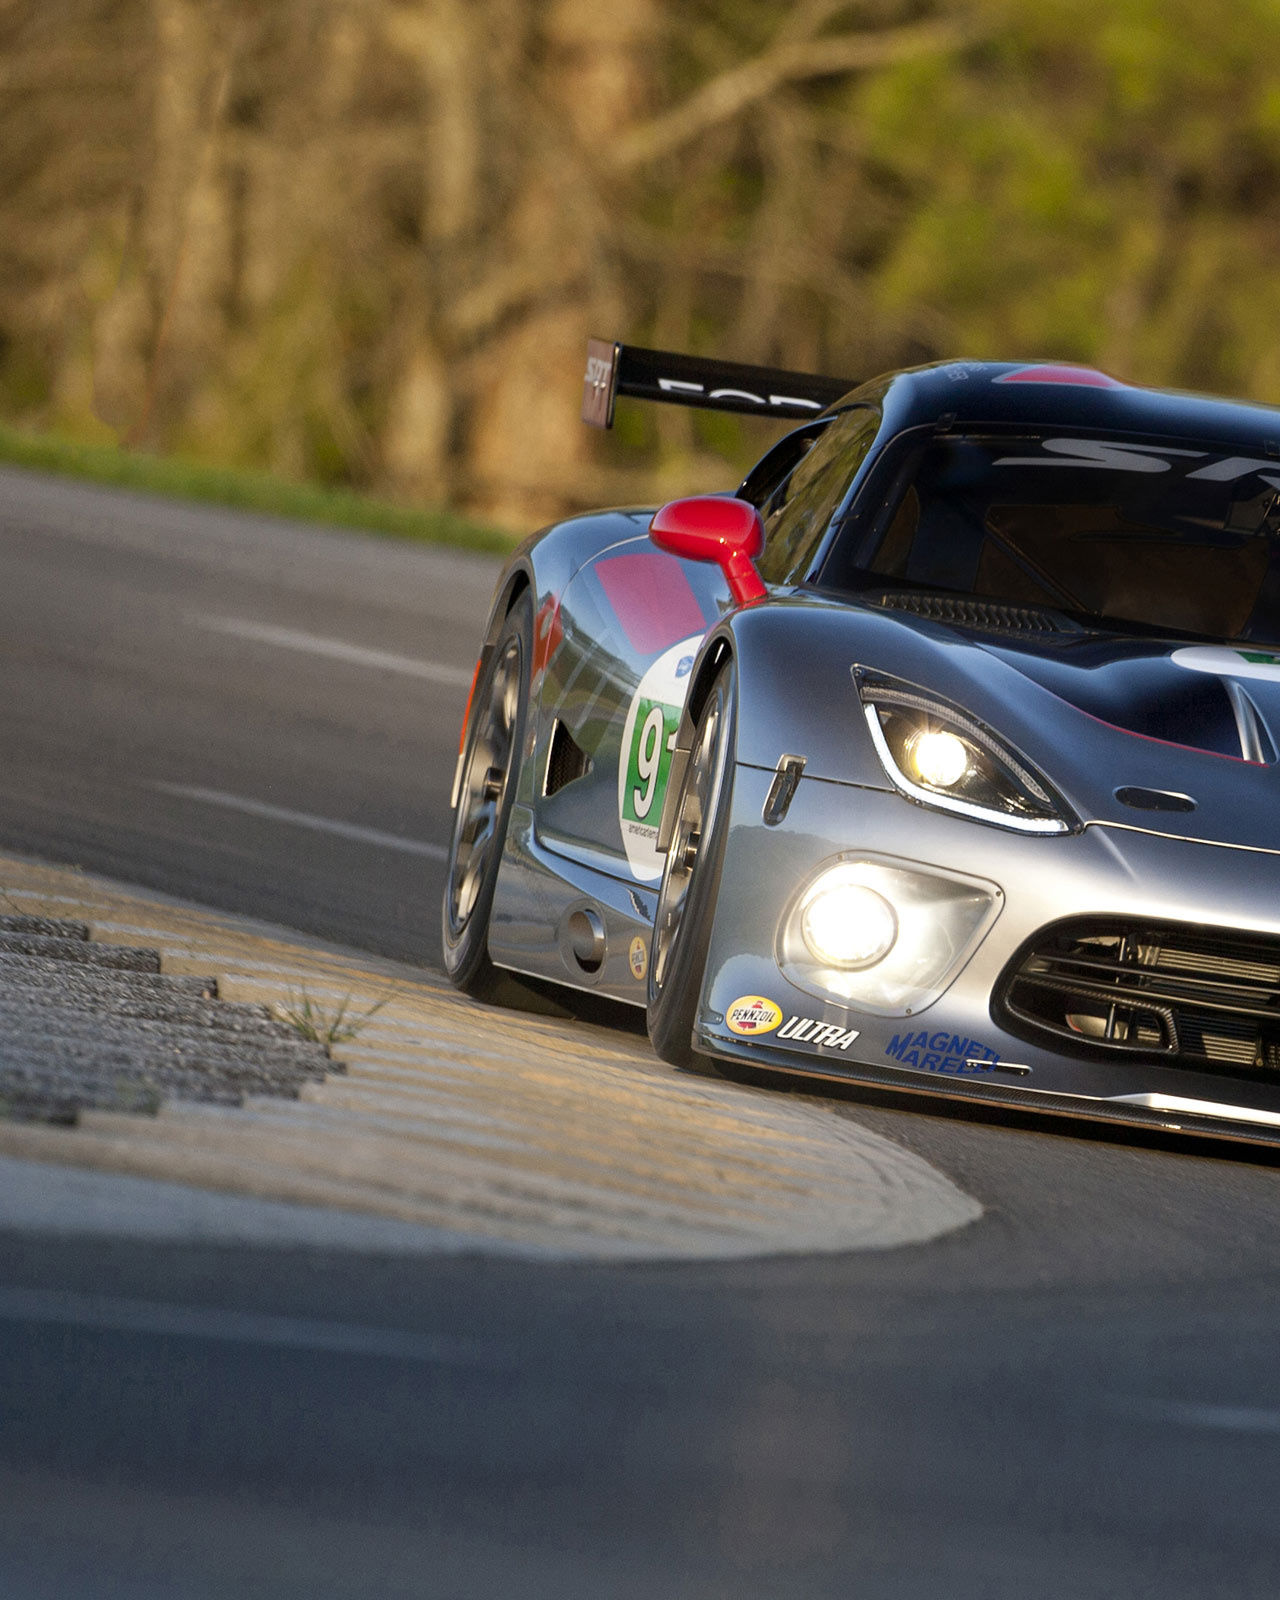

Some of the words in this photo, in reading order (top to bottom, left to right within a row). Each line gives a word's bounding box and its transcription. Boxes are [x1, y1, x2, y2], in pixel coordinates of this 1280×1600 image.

[730, 1009, 776, 1023] PENNZOIL
[776, 1016, 860, 1050] ULTRA
[885, 1031, 1001, 1060] MAGNETI
